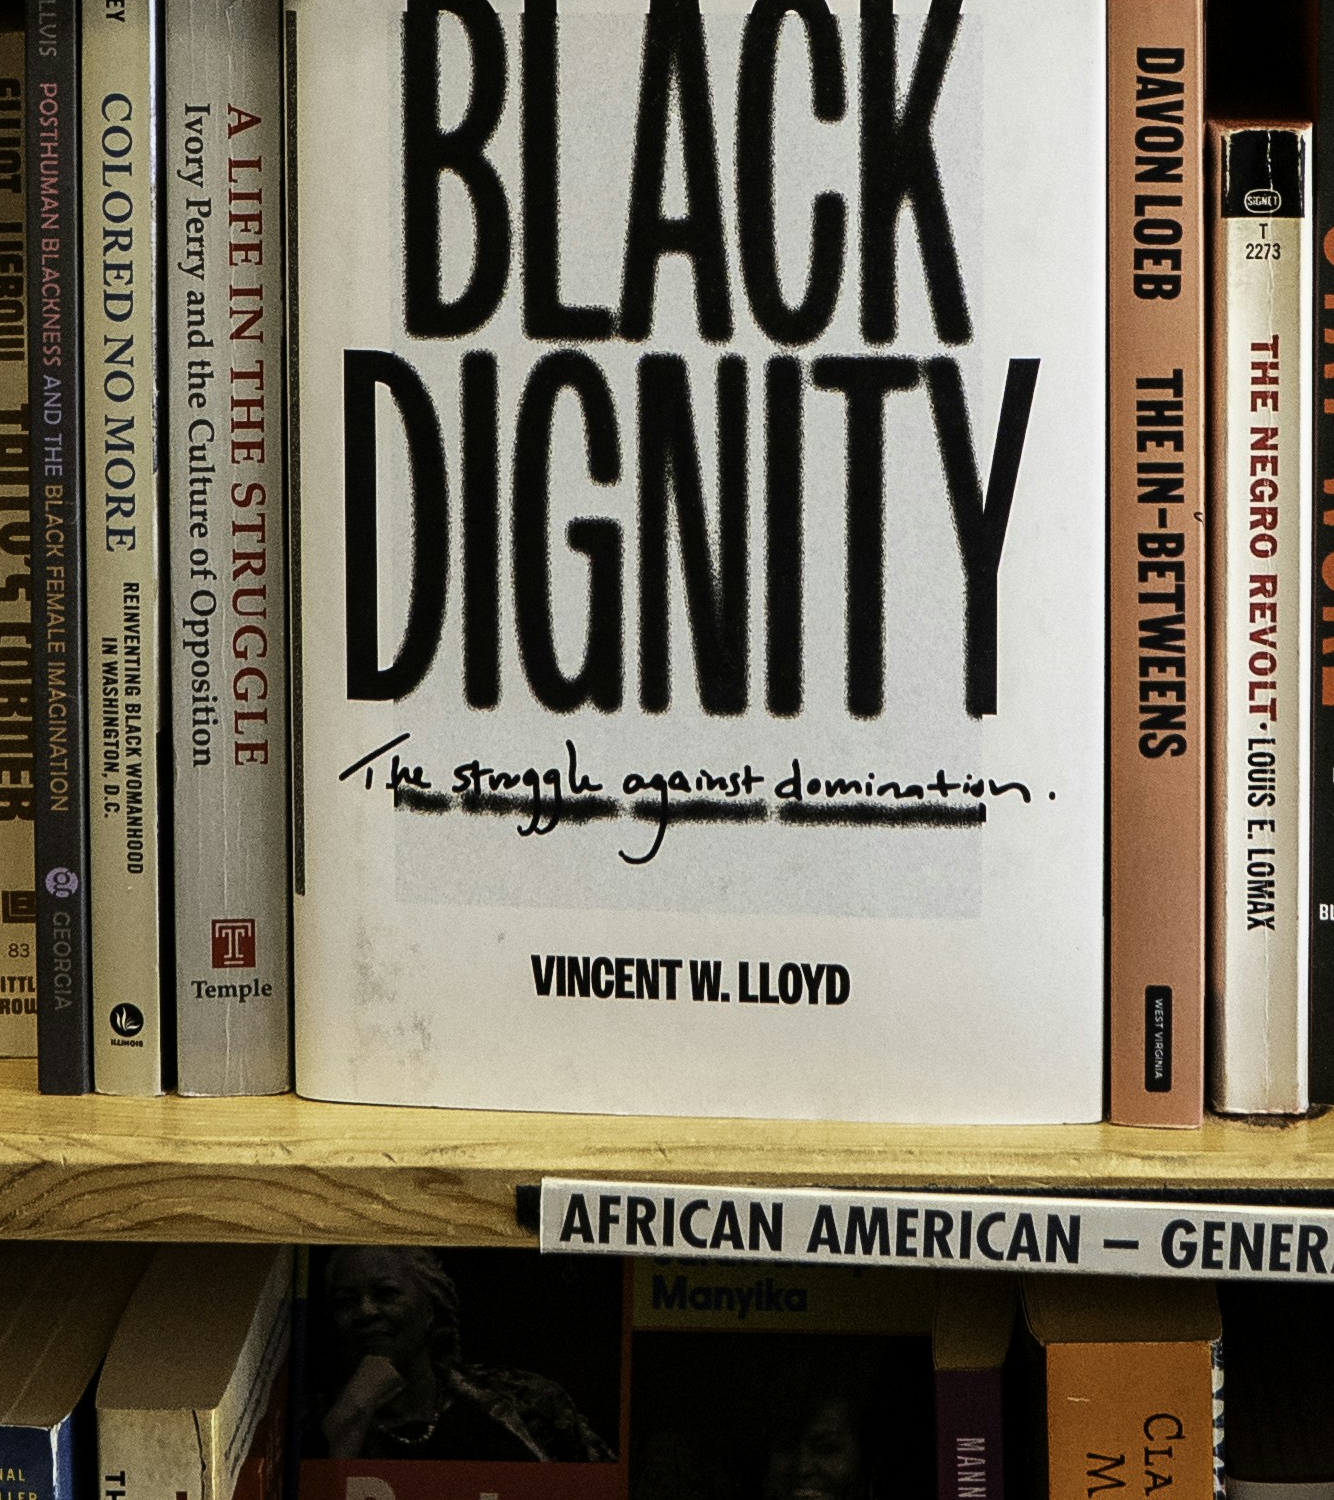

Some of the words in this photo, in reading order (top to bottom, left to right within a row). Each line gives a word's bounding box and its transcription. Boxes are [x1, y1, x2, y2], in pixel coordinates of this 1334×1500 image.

[1259, 223, 1268, 239] T
[1246, 243, 1281, 260] 2273
[344, 349, 1040, 719] DIGNITY
[192, 978, 272, 1004] Temple
[560, 1194, 782, 1251] AFRICAN
[809, 1206, 1080, 1264] AMERICAN
